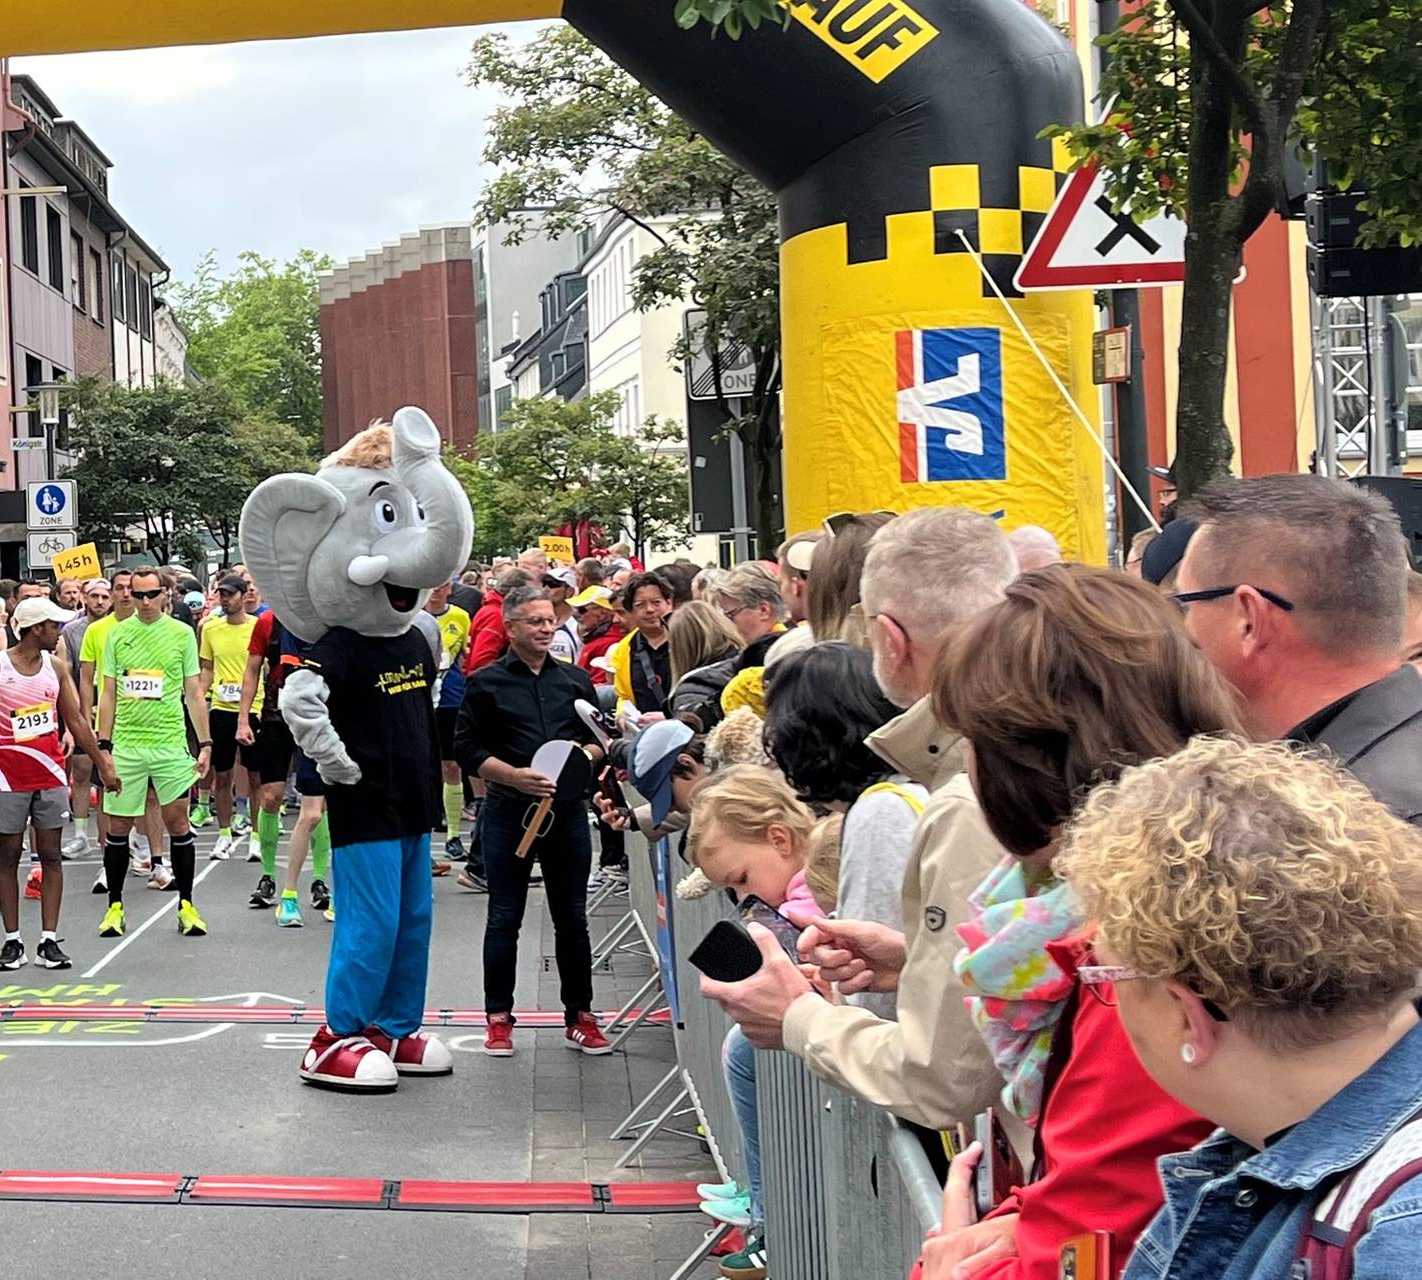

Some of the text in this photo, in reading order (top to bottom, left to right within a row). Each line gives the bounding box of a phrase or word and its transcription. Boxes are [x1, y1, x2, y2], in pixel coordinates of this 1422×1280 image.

[788, 0, 923, 60] AUF
[715, 374, 756, 389] ONE
[39, 517, 63, 525] ZONE
[58, 554, 92, 574] 1.45 h
[130, 680, 154, 691] 1221
[18, 711, 49, 730] 2193
